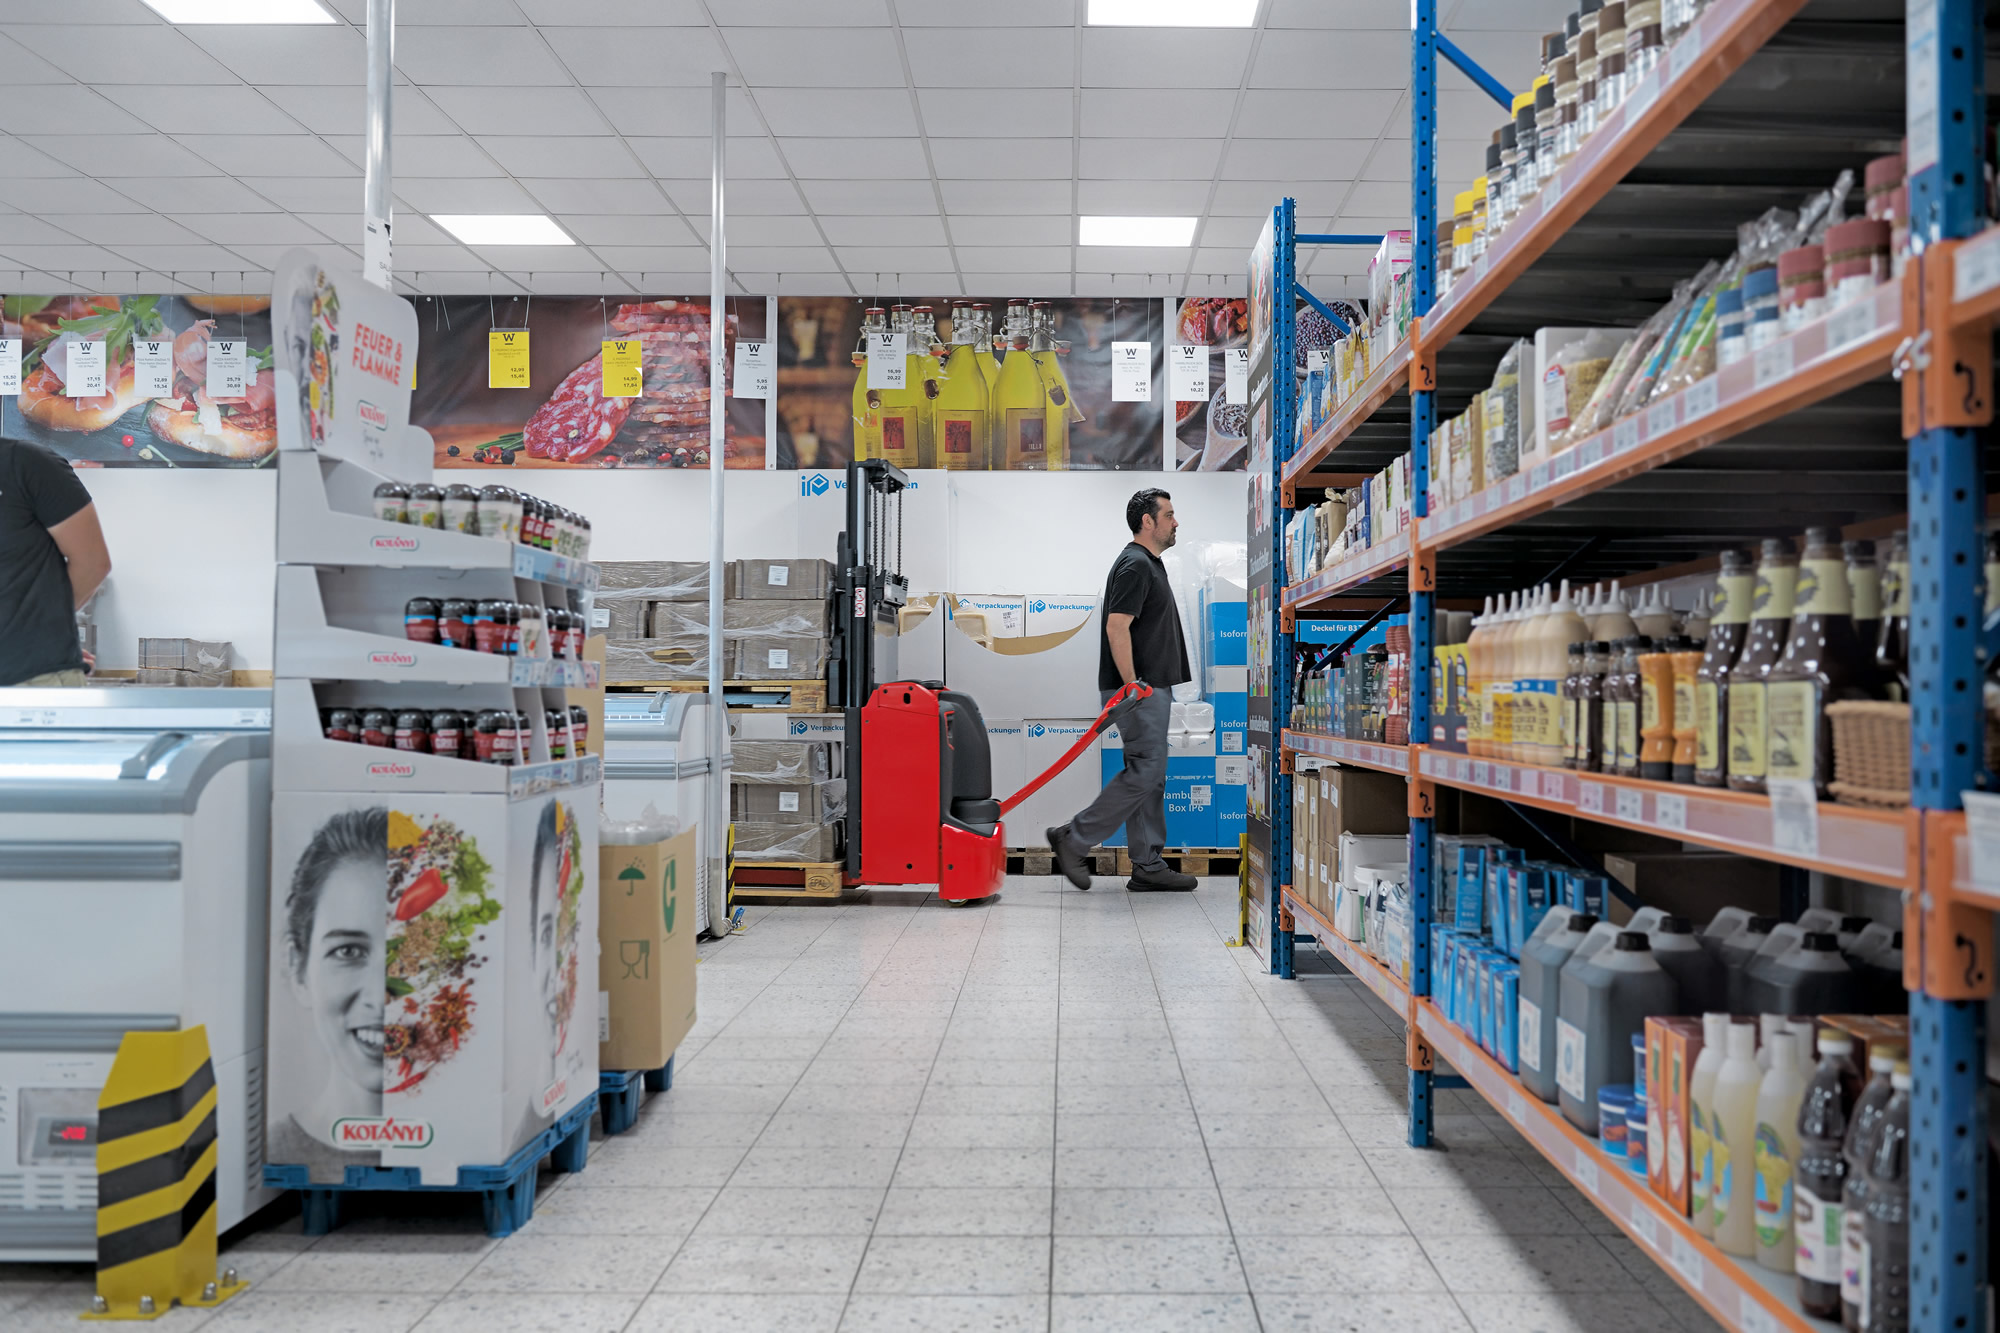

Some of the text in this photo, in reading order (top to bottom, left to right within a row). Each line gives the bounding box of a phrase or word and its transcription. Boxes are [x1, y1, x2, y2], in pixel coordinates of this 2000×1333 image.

[503, 334, 515, 342] W
[881, 334, 894, 343] W
[354, 322, 402, 363] FEUER &
[615, 342, 628, 350] W
[80, 343, 92, 351] W
[148, 343, 160, 351] W
[220, 343, 232, 351] W
[748, 344, 760, 352] W
[1183, 347, 1195, 355] W
[352, 347, 401, 386] FLAMME
[1168, 804, 1186, 812] Box
[343, 1117, 423, 1141] KOTÁNYI
